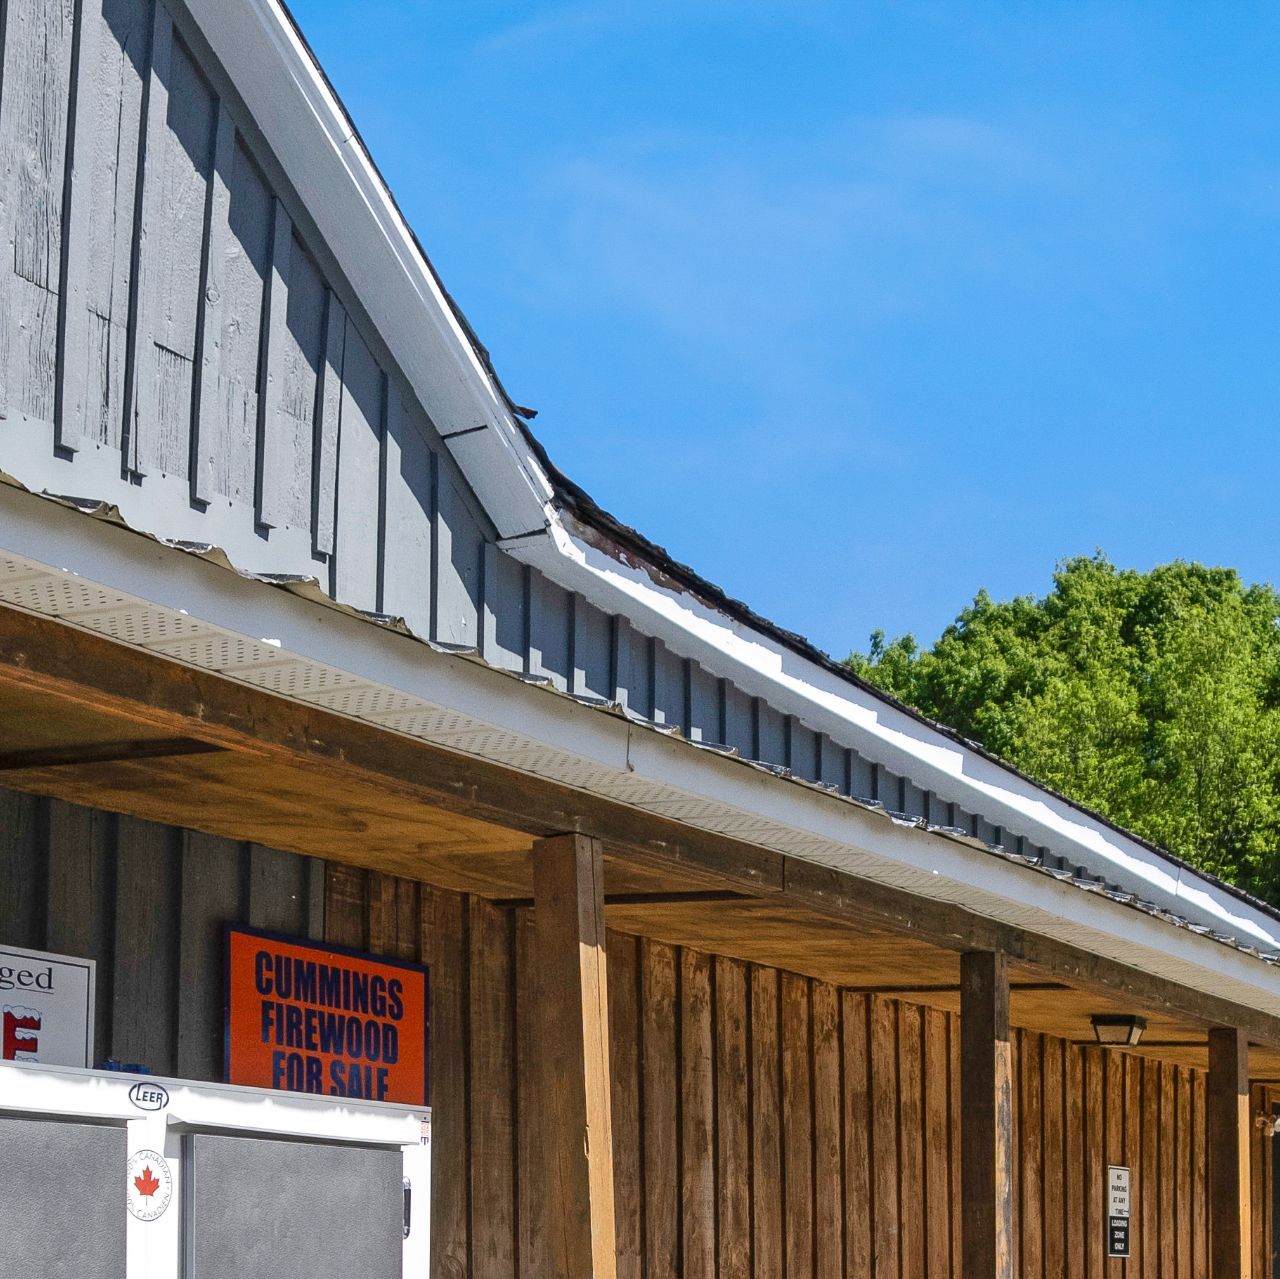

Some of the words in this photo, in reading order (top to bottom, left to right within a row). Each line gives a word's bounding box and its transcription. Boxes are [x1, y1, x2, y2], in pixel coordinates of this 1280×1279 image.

[254, 950, 405, 1021] CUMMINGS
[261, 1000, 399, 1065] FIREWOOD
[272, 1050, 323, 1095] FOR
[329, 1059, 389, 1101] SALE
[135, 1082, 164, 1110] LEER
[138, 1151, 171, 1184] CANADIAN
[1112, 1184, 1127, 1192] PARKING
[1111, 1219, 1127, 1227] LOADING
[1114, 1231, 1125, 1239] ZONE
